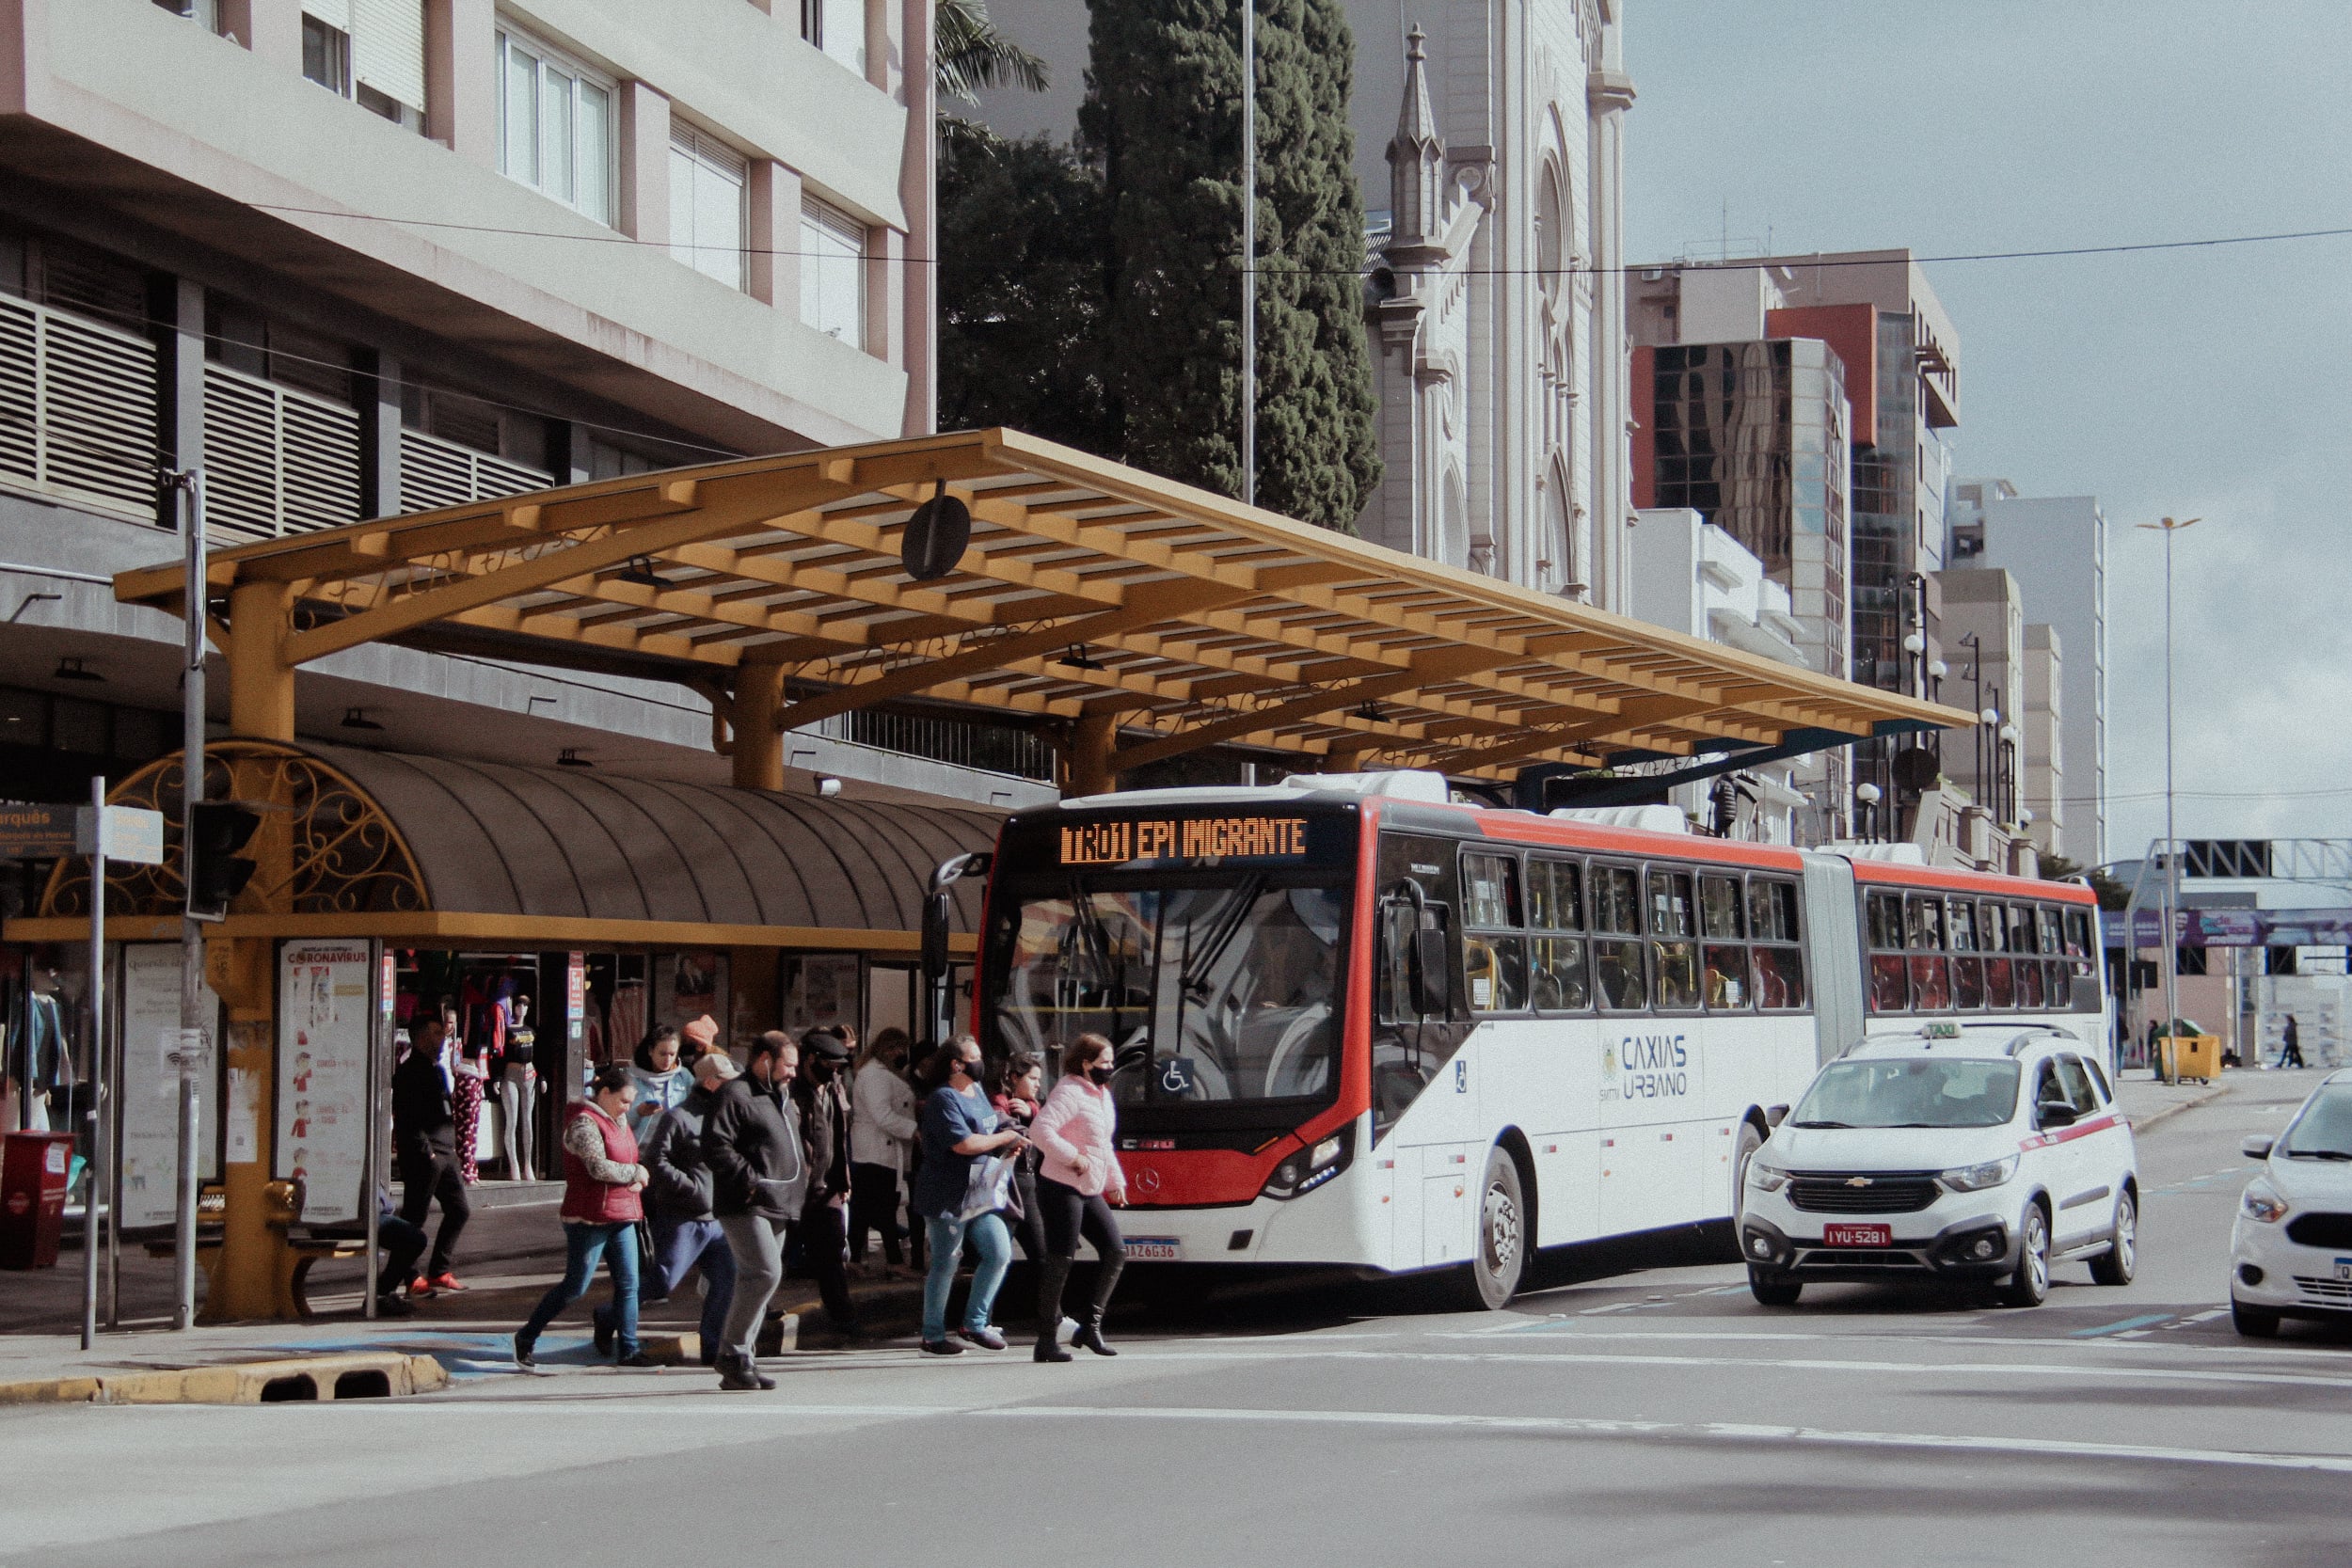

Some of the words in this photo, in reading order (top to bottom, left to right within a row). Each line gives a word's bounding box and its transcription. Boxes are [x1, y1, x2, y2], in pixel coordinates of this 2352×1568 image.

[1136, 821, 1175, 859] EPI
[1182, 817, 1308, 858] IMIGRANTE
[1622, 1035, 1687, 1070] CAXIAS
[1624, 1071, 1687, 1100] URBANO
